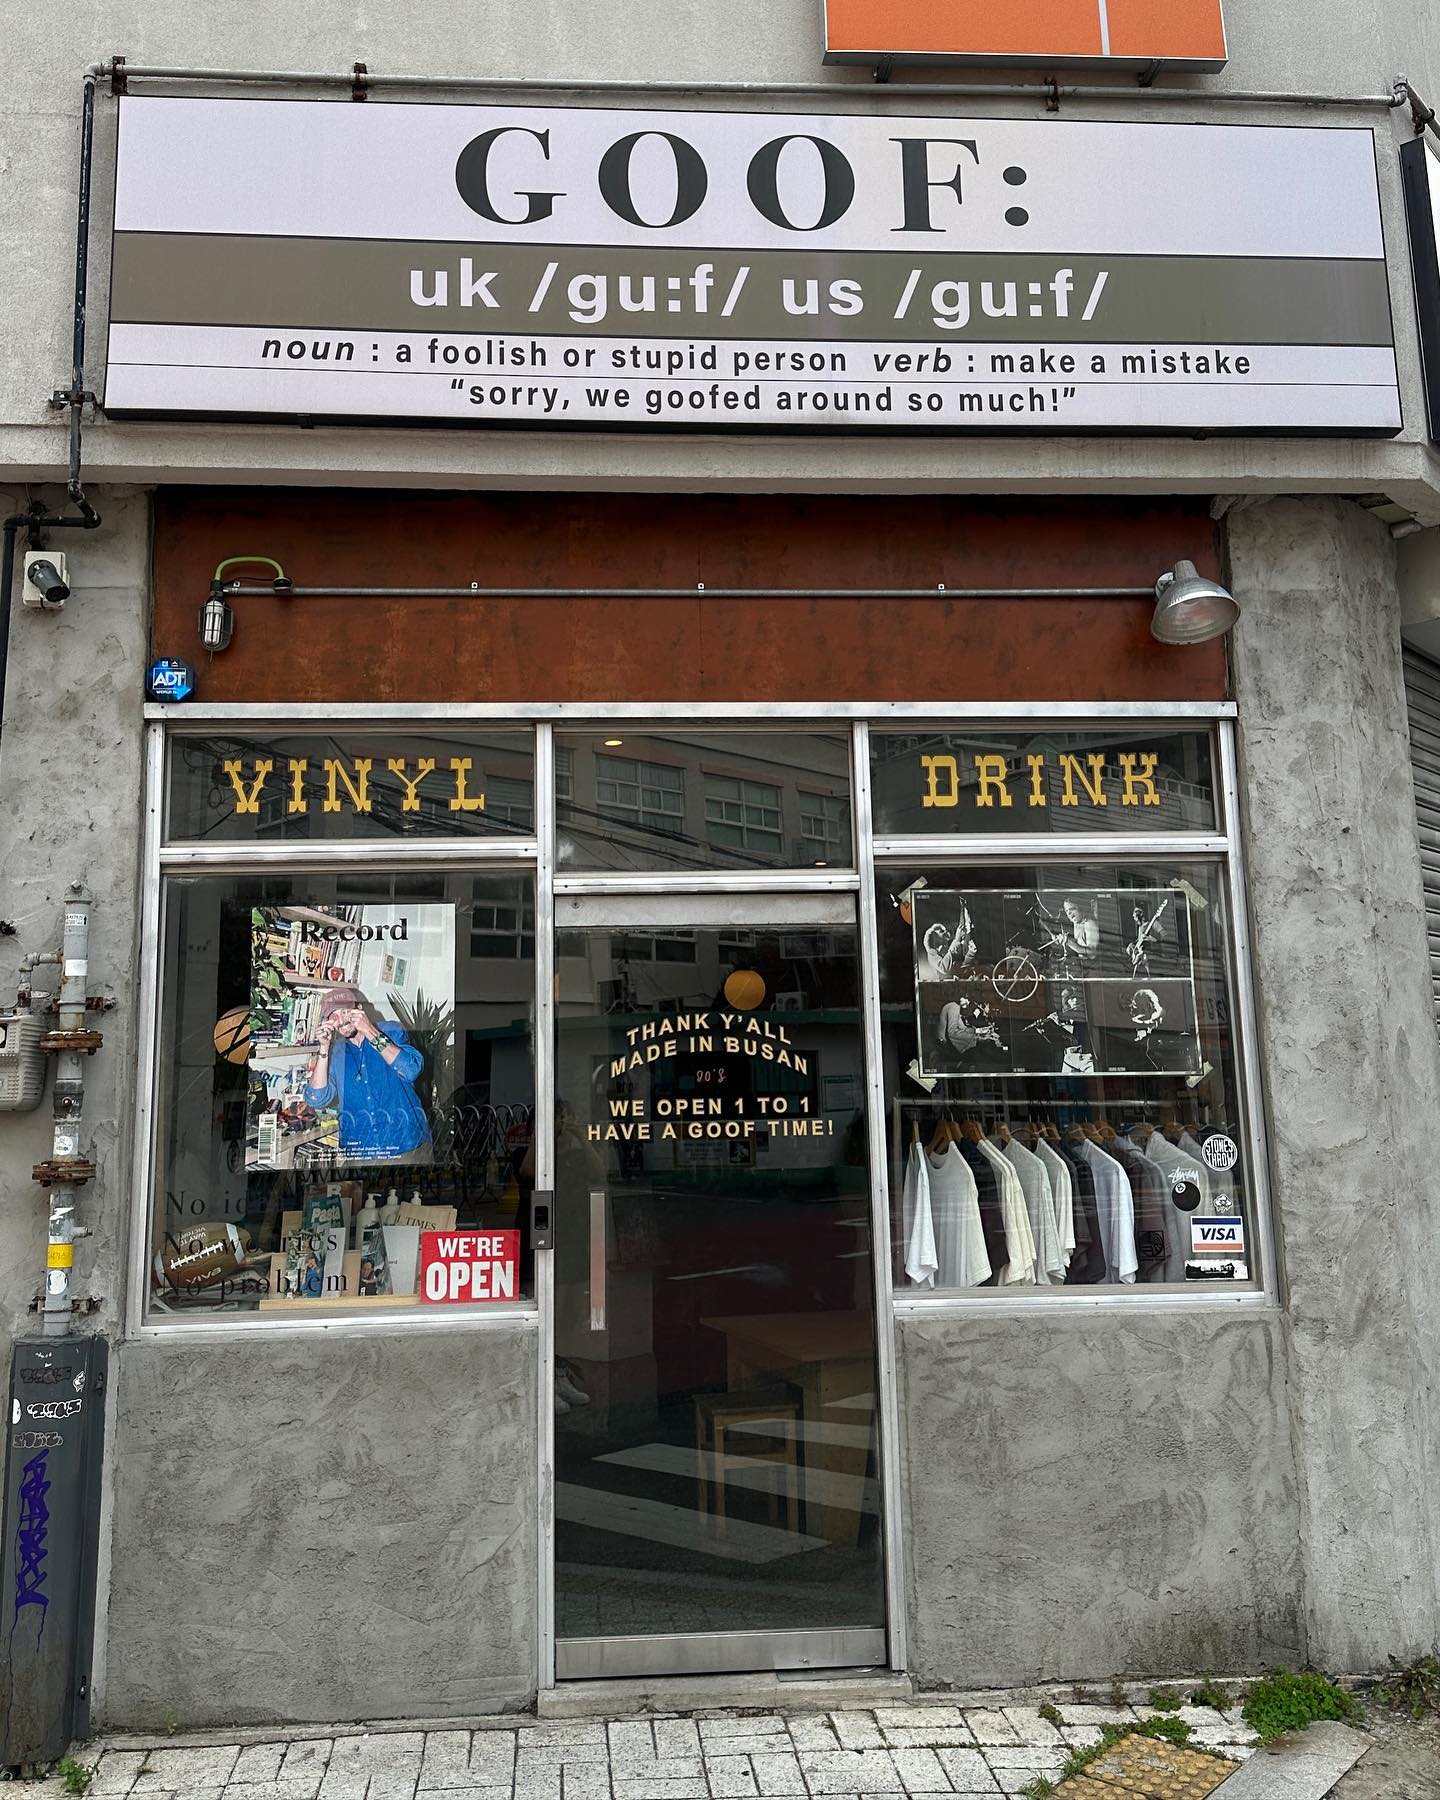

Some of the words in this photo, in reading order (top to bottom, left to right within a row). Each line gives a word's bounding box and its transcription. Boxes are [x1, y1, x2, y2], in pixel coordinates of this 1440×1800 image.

[456, 125, 1030, 233] GOOF:
[411, 258, 500, 308] uk
[528, 262, 751, 324] /gu:f/
[782, 280, 864, 316] us
[893, 268, 1109, 330] /gu:f/
[261, 339, 355, 361] noun
[395, 343, 412, 363] a
[428, 338, 548, 367] foolish
[564, 347, 597, 368] or
[611, 343, 718, 373] stupid
[733, 349, 847, 377] person
[874, 346, 952, 373] verb
[990, 349, 1075, 374] make
[1090, 355, 1106, 374] a
[1121, 349, 1251, 375] mistake
[585, 388, 630, 408] we
[646, 381, 761, 415] goofed
[776, 384, 893, 412] around
[907, 393, 943, 412] so
[153, 671, 185, 686] ADT
[223, 757, 485, 814] VINYL
[921, 754, 1161, 807] DRINK
[299, 917, 409, 943] Record
[626, 1013, 711, 1047] THANK
[720, 1013, 792, 1045] Y'ALL
[610, 1039, 677, 1079] MADE
[689, 1035, 713, 1053] IN
[726, 1036, 808, 1076] BUSAN
[609, 1100, 645, 1117] WE
[656, 1098, 722, 1116] OPEN
[735, 1098, 744, 1114] 1
[757, 1097, 788, 1114] TO
[800, 1096, 809, 1113] 1
[587, 1123, 651, 1141] HAVE
[661, 1122, 677, 1139] A
[688, 1120, 755, 1139] GOOF
[767, 1119, 833, 1137] TIME!
[1205, 1138, 1234, 1153] STONES
[1207, 1152, 1234, 1167] THROW
[406, 1217, 437, 1231] TIMES
[1200, 1227, 1237, 1241] VISA
[437, 1236, 505, 1258] WE'RE
[426, 1260, 514, 1301] OPEN
